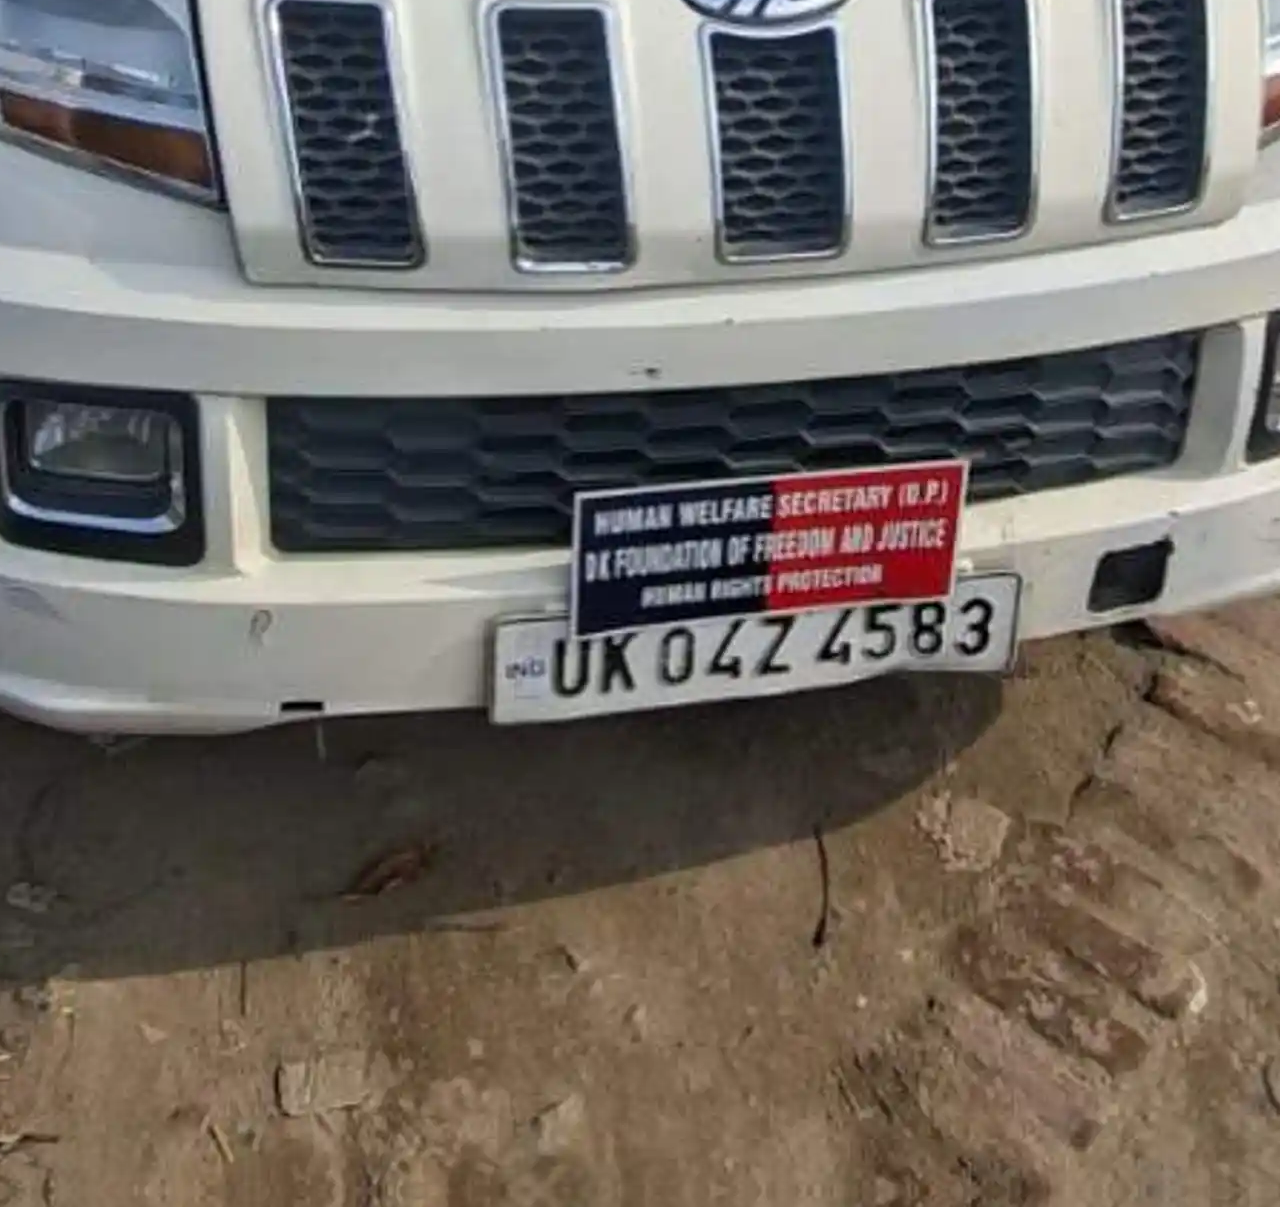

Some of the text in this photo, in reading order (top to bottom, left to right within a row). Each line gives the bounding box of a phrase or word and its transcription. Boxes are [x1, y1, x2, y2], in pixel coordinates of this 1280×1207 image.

[594, 503, 674, 537] HUMAN
[678, 494, 774, 527] WELFARE
[776, 486, 894, 518] SECRETARY
[613, 538, 723, 580] FOUNDATION
[727, 533, 751, 567] OF
[752, 526, 838, 563] FREEDOM
[839, 523, 875, 554] AND
[876, 518, 947, 551] JUSTICE
[640, 563, 883, 609] HUMAN RIGHTS PROTECTION
[553, 631, 638, 698] UK
